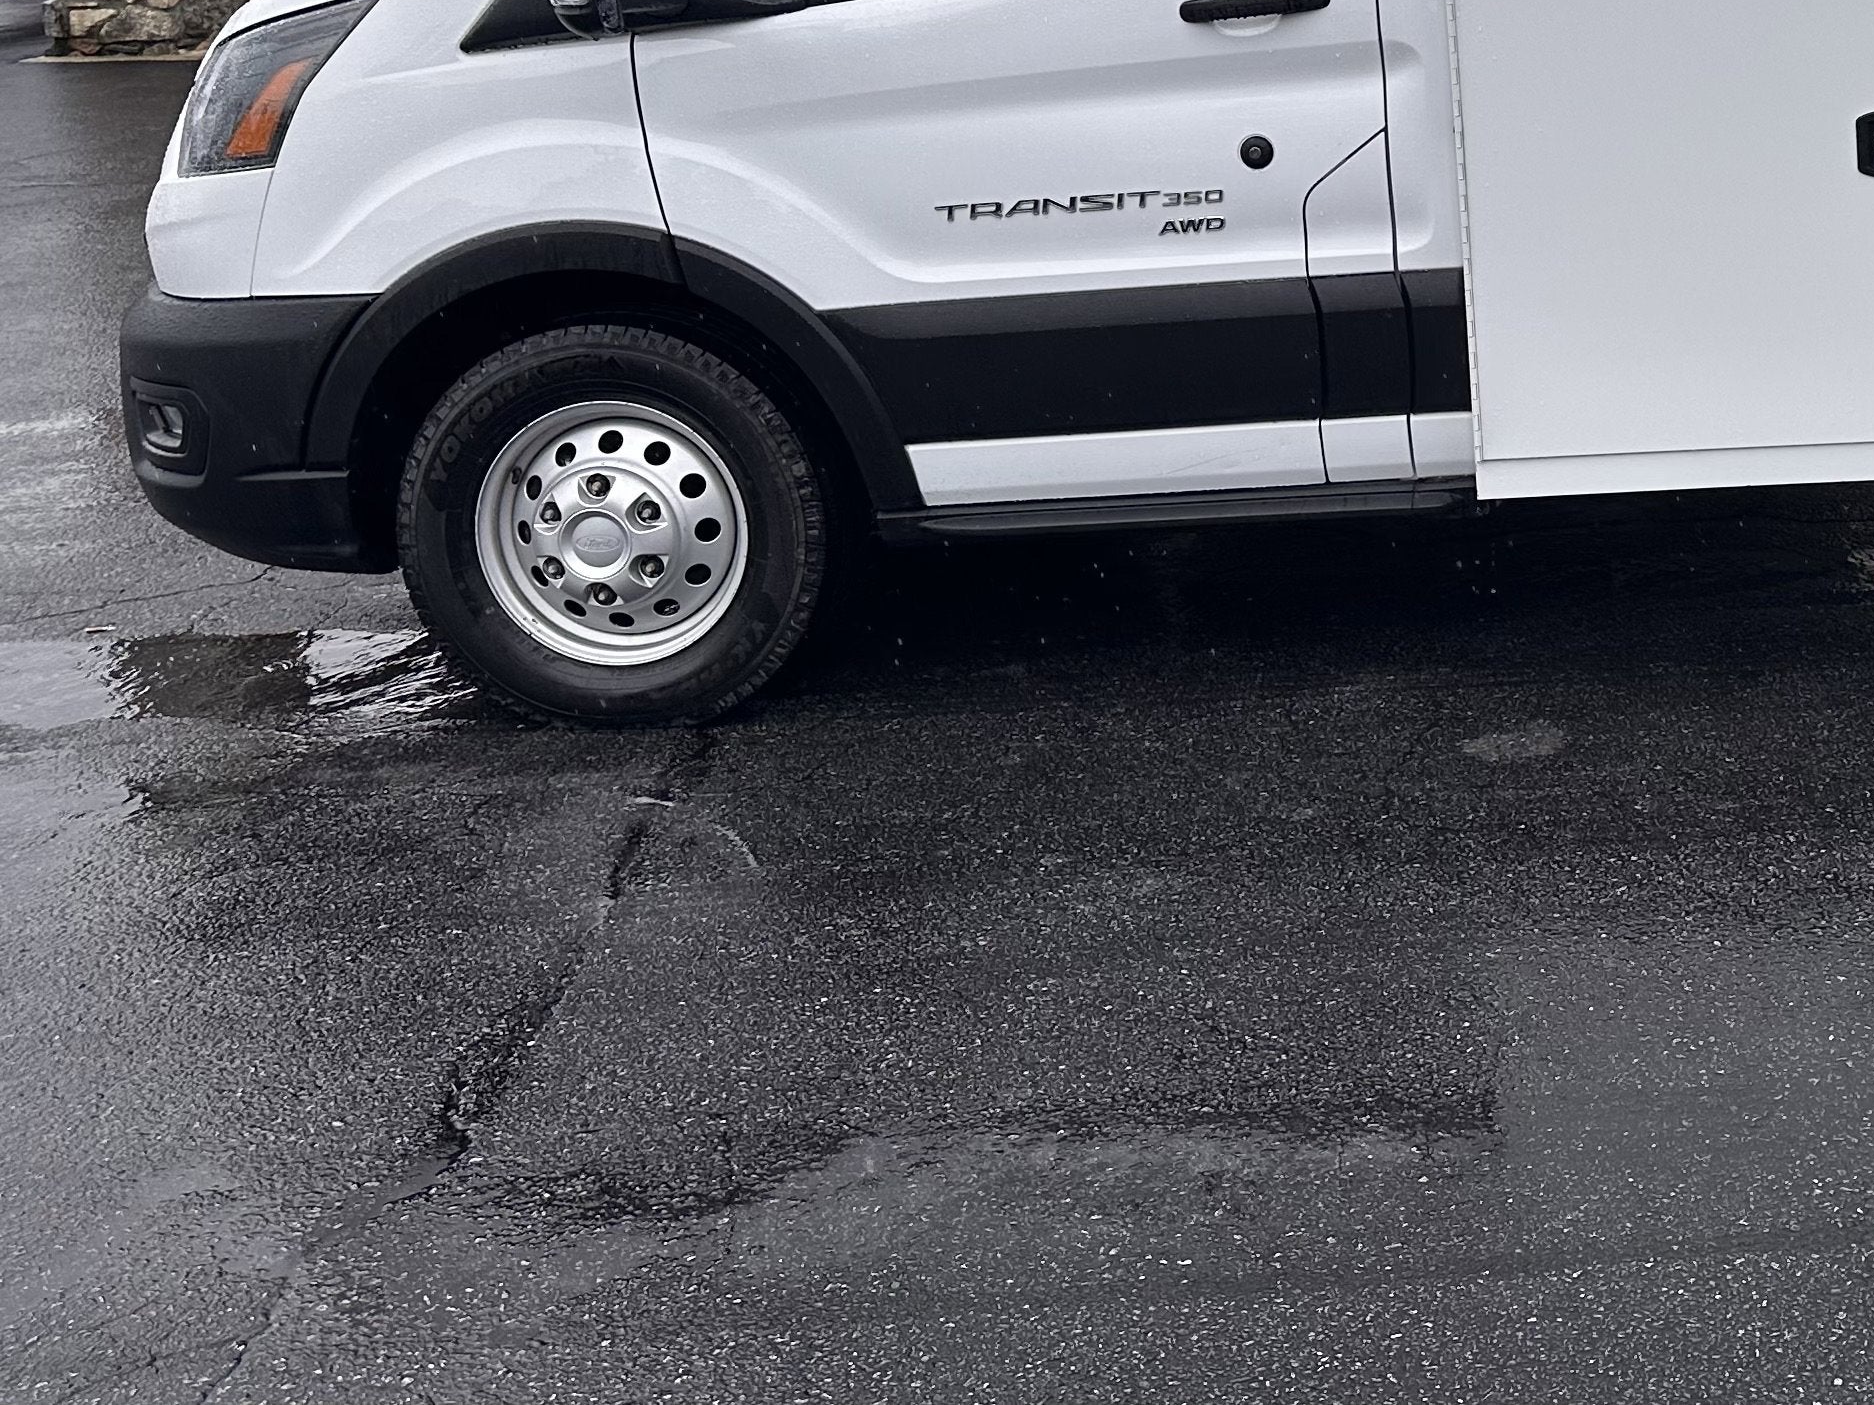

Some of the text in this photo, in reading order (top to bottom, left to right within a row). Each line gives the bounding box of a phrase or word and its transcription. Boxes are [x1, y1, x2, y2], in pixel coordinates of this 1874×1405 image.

[933, 189, 1224, 222] TRANSIT 350
[1158, 215, 1226, 237] AWD
